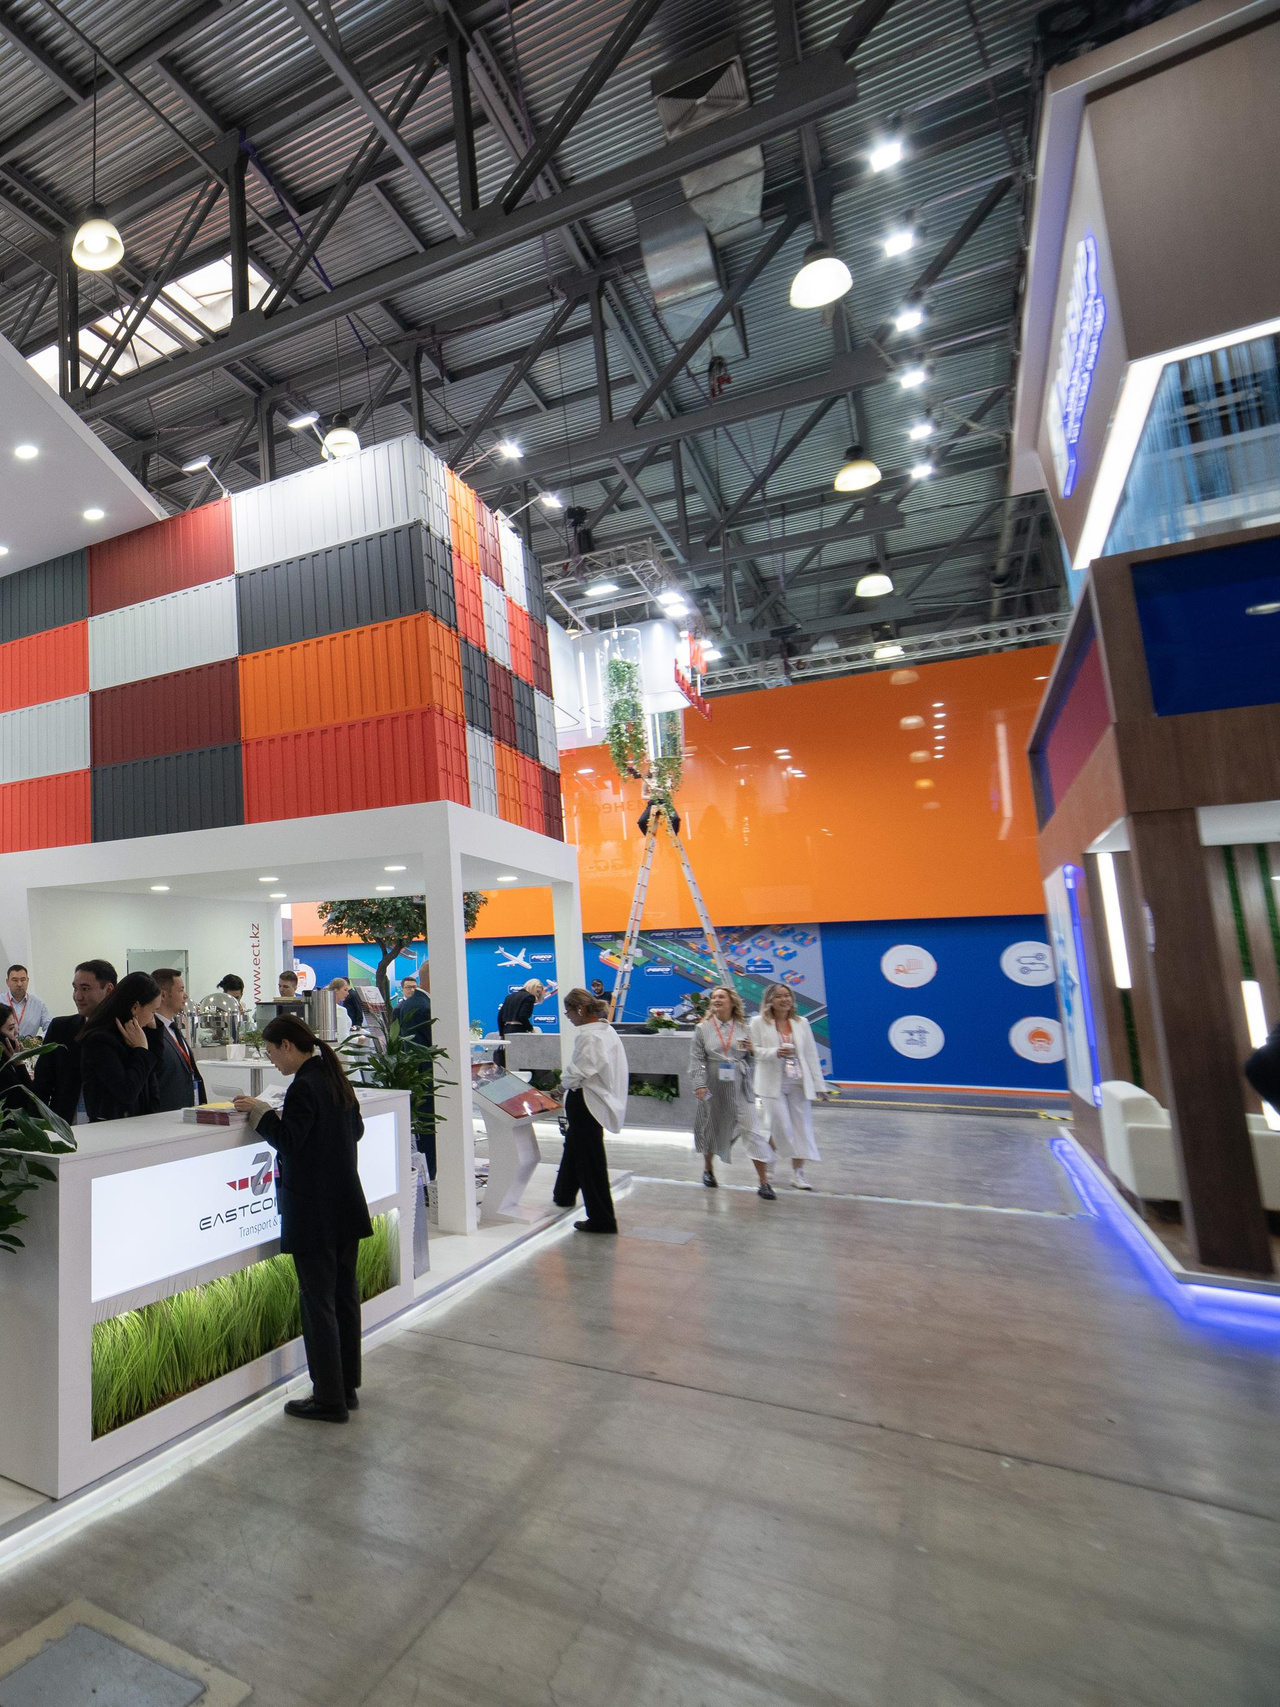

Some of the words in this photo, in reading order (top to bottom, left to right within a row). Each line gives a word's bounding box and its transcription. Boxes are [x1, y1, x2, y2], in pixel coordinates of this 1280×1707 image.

[199, 1197, 277, 1231] EASTCO
[239, 1219, 272, 1238] Transport
[273, 1215, 278, 1227] &
